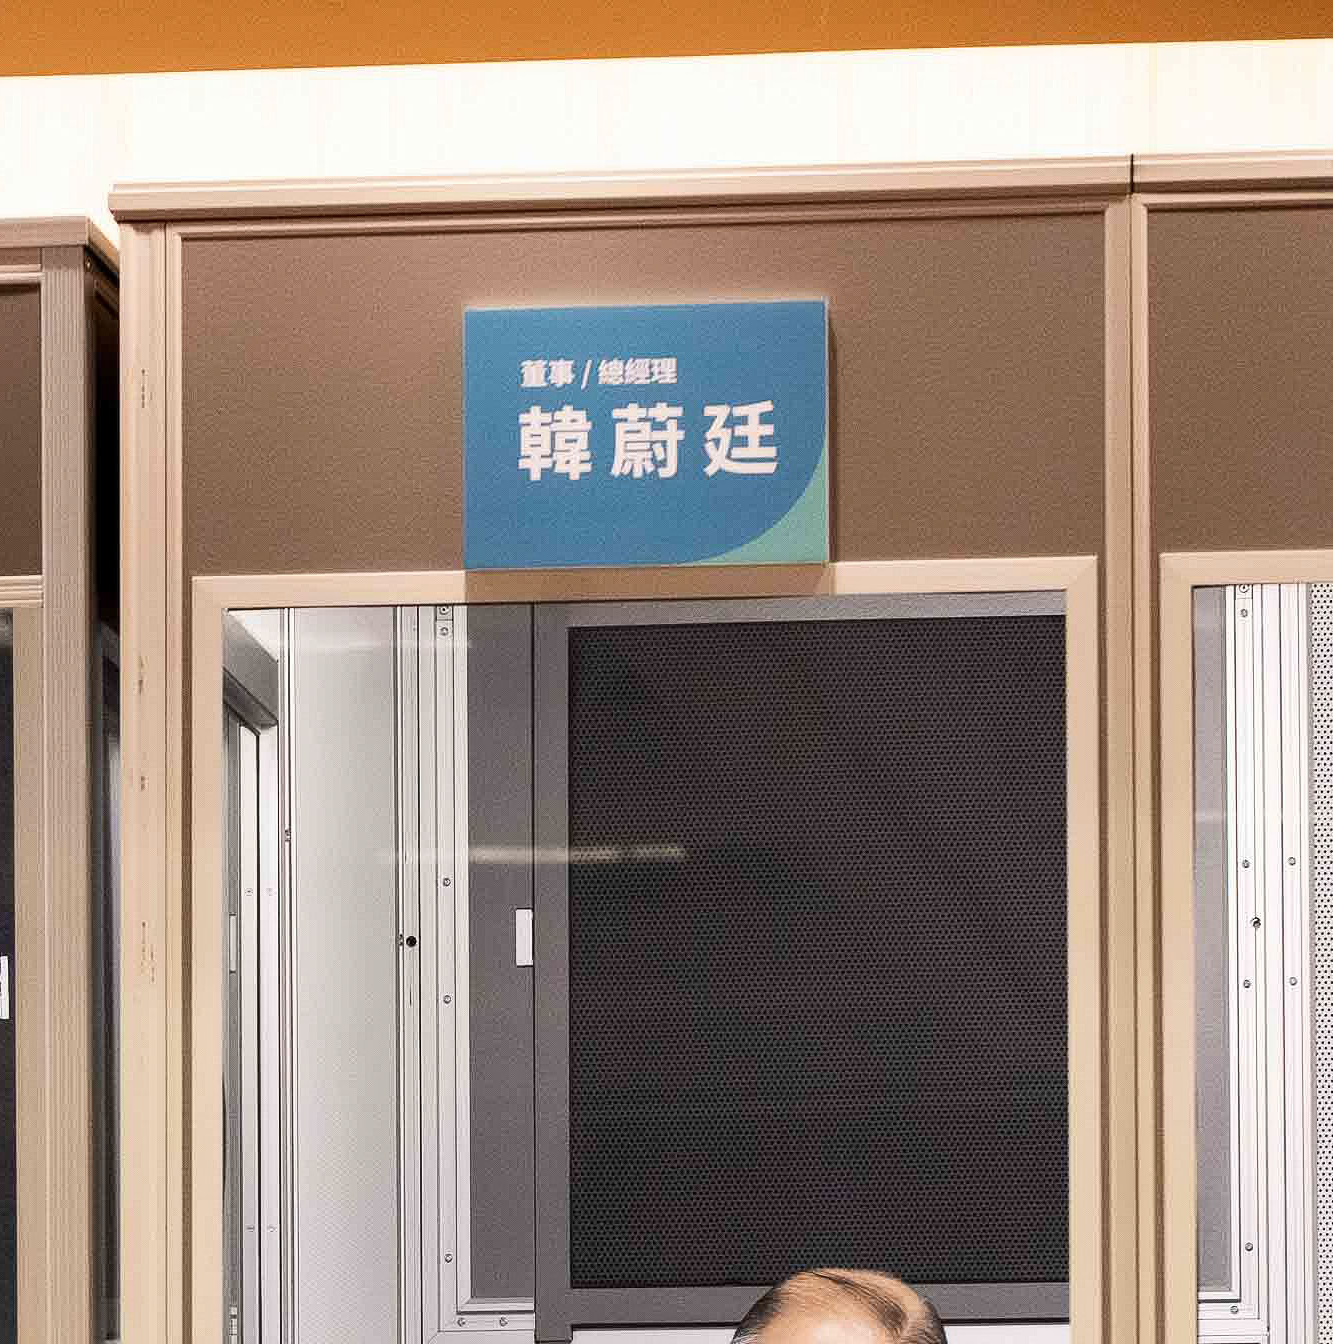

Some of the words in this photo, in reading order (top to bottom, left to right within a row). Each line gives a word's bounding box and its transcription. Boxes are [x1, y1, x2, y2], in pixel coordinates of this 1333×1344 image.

[520, 358, 575, 389] 董事
[597, 357, 678, 386] 總經理
[518, 400, 778, 481] 韓蔚廷
